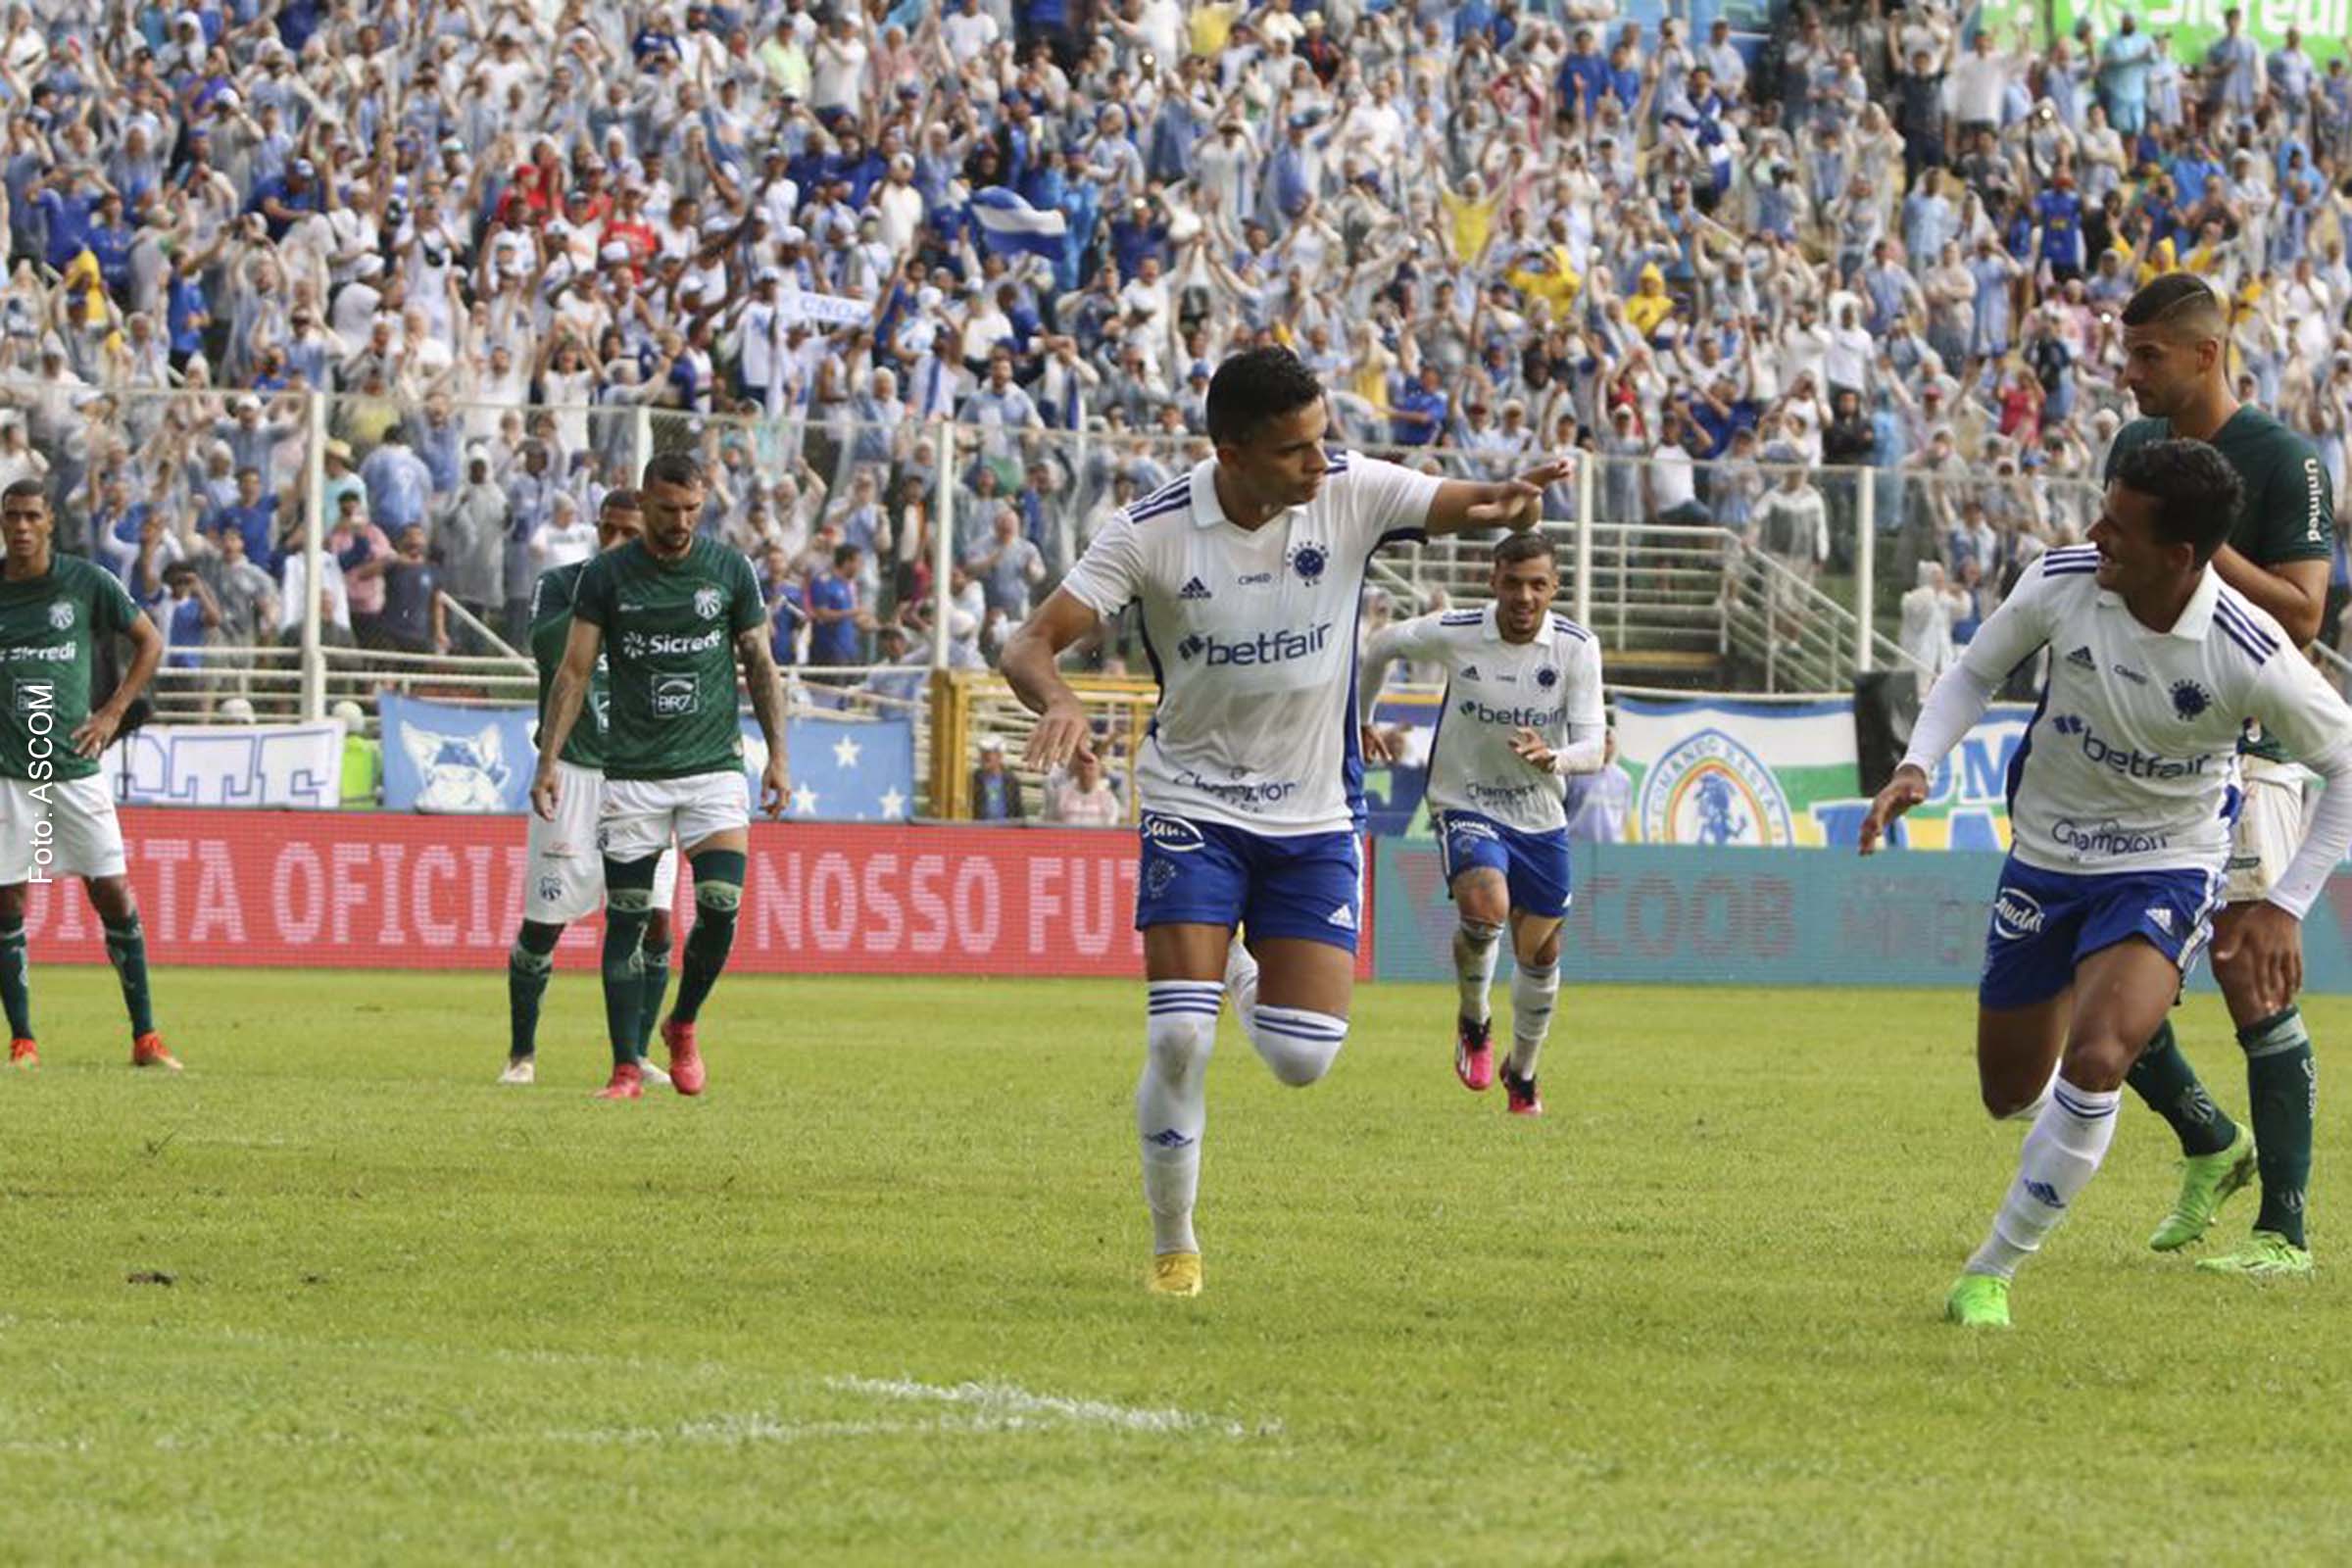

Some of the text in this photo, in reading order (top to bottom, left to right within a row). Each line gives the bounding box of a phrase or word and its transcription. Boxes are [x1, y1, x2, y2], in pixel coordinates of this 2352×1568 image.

[2304, 458, 2324, 541] Unimed
[1206, 622, 1332, 666] betfair
[1478, 704, 1565, 726] betfair
[2082, 726, 2211, 779] betfair
[2052, 818, 2170, 855] Champion
[756, 850, 1002, 956] NOSSO
